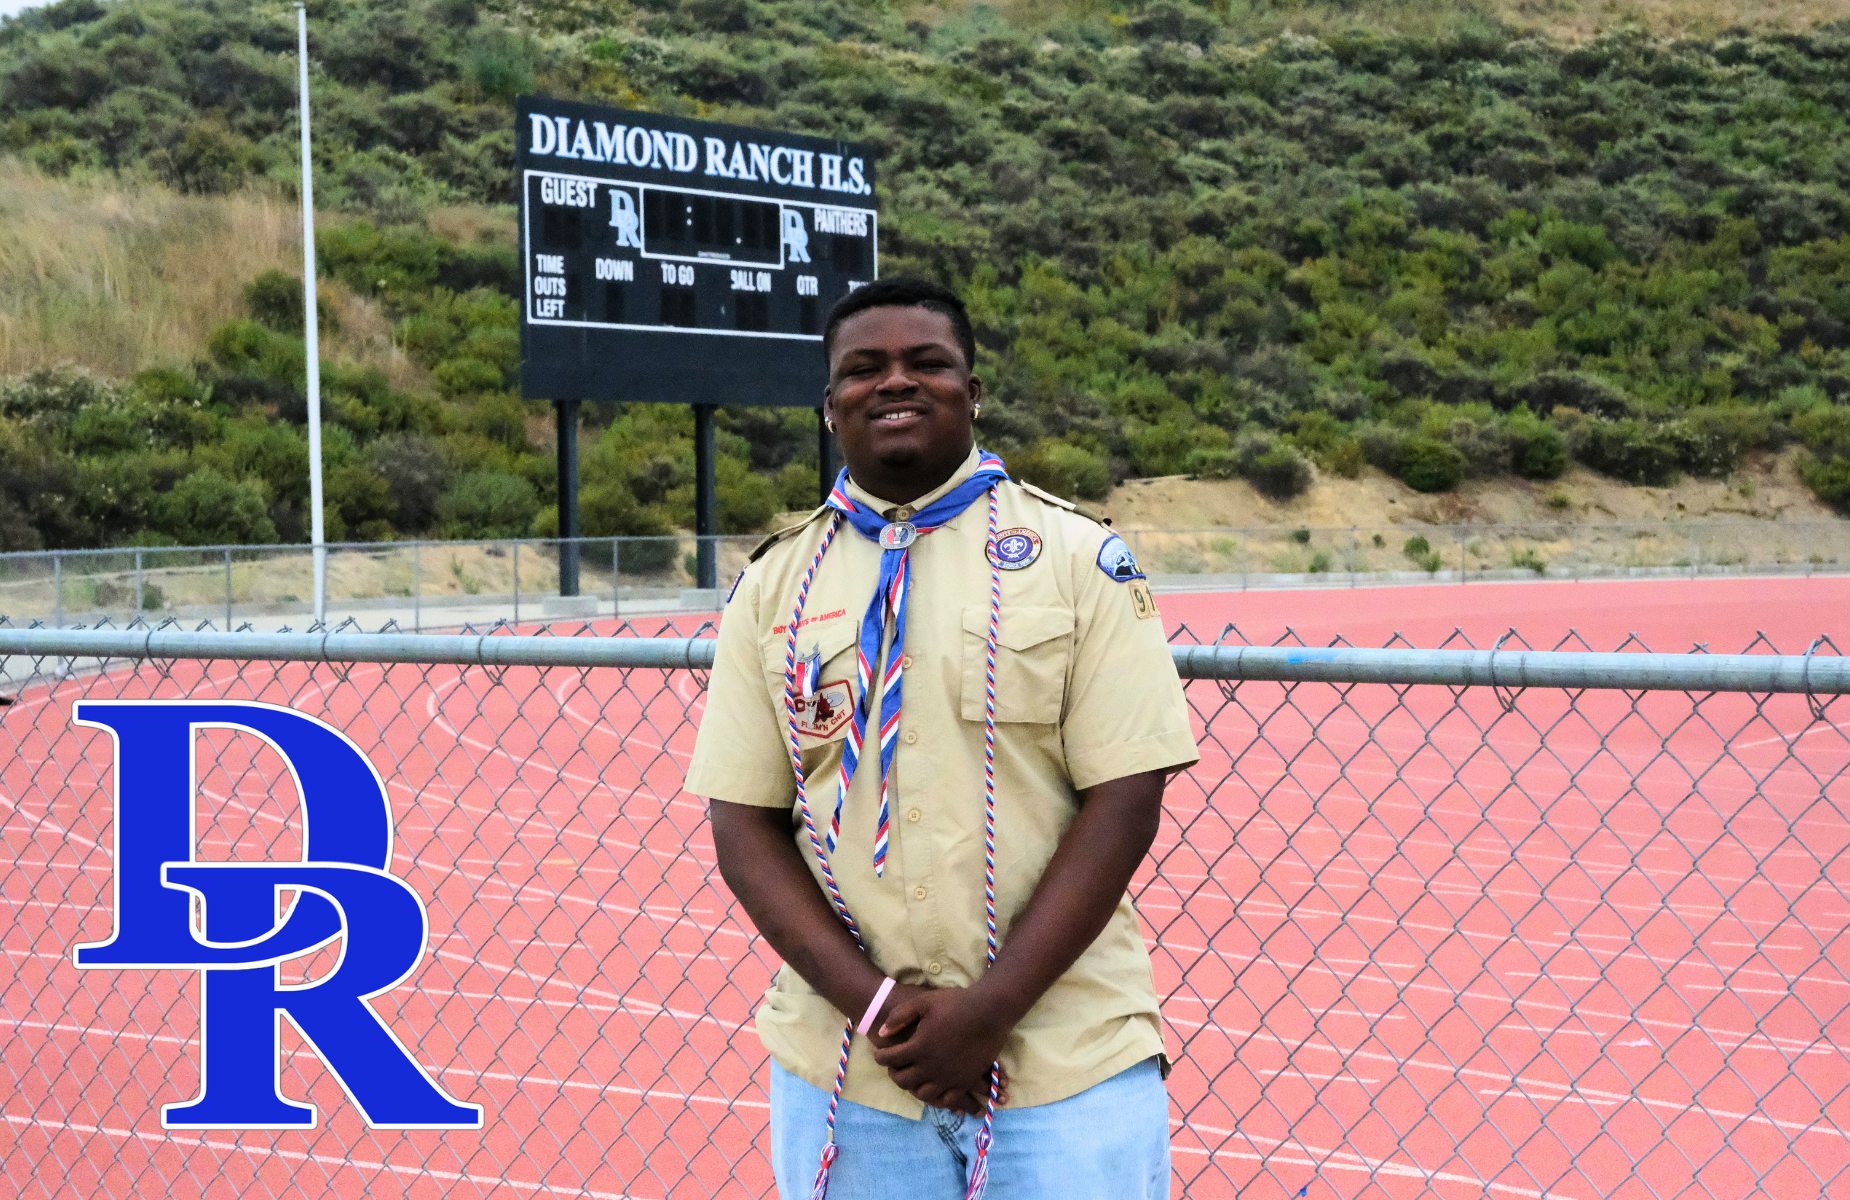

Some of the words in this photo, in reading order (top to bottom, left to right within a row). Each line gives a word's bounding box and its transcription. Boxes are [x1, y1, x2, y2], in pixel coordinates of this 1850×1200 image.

[529, 113, 698, 173] DIAMOND
[704, 137, 814, 188] RANCH
[820, 153, 872, 196] H.S.
[541, 177, 597, 208] GUEST
[814, 207, 867, 237] PANTHERS
[535, 254, 565, 274] TIME
[595, 258, 634, 281] DOWN
[660, 262, 677, 284] TO
[678, 265, 695, 286] GO
[534, 276, 567, 296] OUTS
[756, 271, 772, 293] ON
[536, 298, 565, 318] LEFT
[773, 625, 787, 634] BOY
[819, 608, 847, 621] AMERICA
